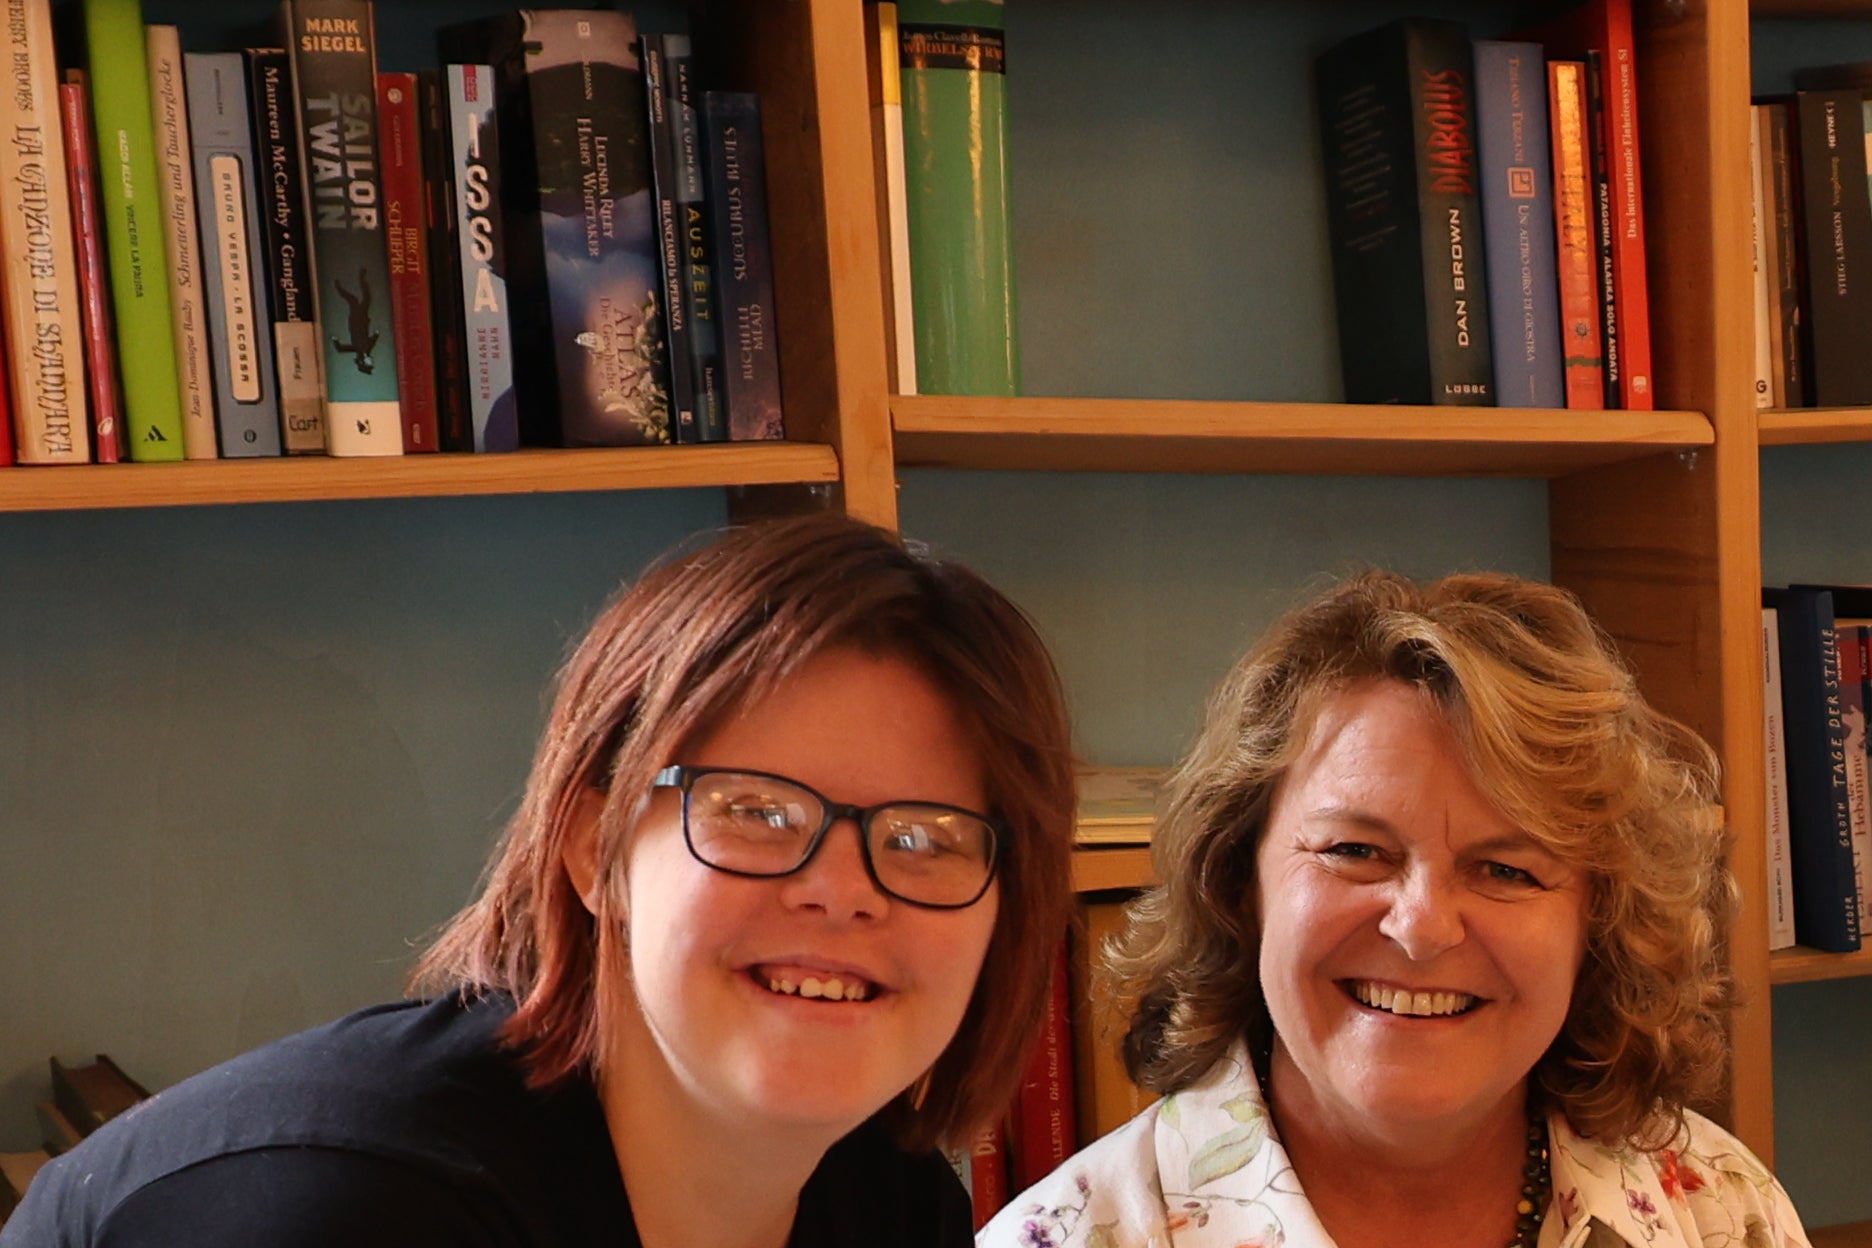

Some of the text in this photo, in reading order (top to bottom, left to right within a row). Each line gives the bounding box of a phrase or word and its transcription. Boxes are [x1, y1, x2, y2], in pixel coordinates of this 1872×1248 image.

[300, 35, 367, 53] SIEGEL
[305, 17, 359, 34] MARK
[14, 53, 34, 112] BROOKS
[263, 65, 281, 138] Maureen
[1620, 63, 1633, 146] Einheitensystem
[14, 125, 41, 157] LA
[306, 97, 347, 231] TWAIN
[346, 93, 378, 231] SAILOR
[159, 60, 191, 291] Schmetterling und Taucherglocke
[270, 143, 291, 226] McCarthy
[576, 117, 600, 257] HARRY WHITTAKER
[594, 135, 615, 240] LUCINDA RILEY
[723, 127, 748, 281] SUCCUBUS BLUES
[1623, 146, 1637, 216] internationale
[19, 159, 55, 279] CANZONE
[387, 200, 405, 275] SCHLIEPER
[465, 112, 499, 313] ISSA
[661, 199, 677, 267] RILANCIAMO
[1518, 204, 1531, 225] UN
[1518, 227, 1531, 264] ALTRO
[1626, 217, 1638, 239] Das
[1832, 211, 1845, 261] LARSSON
[223, 172, 249, 383] BRUNO VESPA LA SCOSSA
[279, 243, 300, 322] Gangland
[404, 228, 420, 275] BIRGIT
[687, 207, 710, 320] AUSZEIT
[1448, 208, 1469, 346] DAN BROWN
[1600, 183, 1619, 383] PATAGONIA ALASKA SOLO ANDATA
[1836, 262, 1848, 297] STIEG
[33, 289, 61, 318] DI
[599, 297, 612, 320] Die
[668, 278, 682, 331] SPERANZA
[750, 303, 763, 350] MEAD
[1525, 312, 1537, 363] GIOSTRA
[614, 307, 641, 399] ATLAS
[1767, 714, 1777, 754] Bozen
[1771, 784, 1781, 835] Monster
[1821, 628, 1857, 942] HERDER GROTH TAGE DER STILLE
[1854, 755, 1867, 837] Hebamme
[1773, 838, 1783, 862] Das
[1046, 1047, 1058, 1079] Stadt
[1048, 1082, 1060, 1101] Die
[1049, 1108, 1063, 1162] LLENDE
